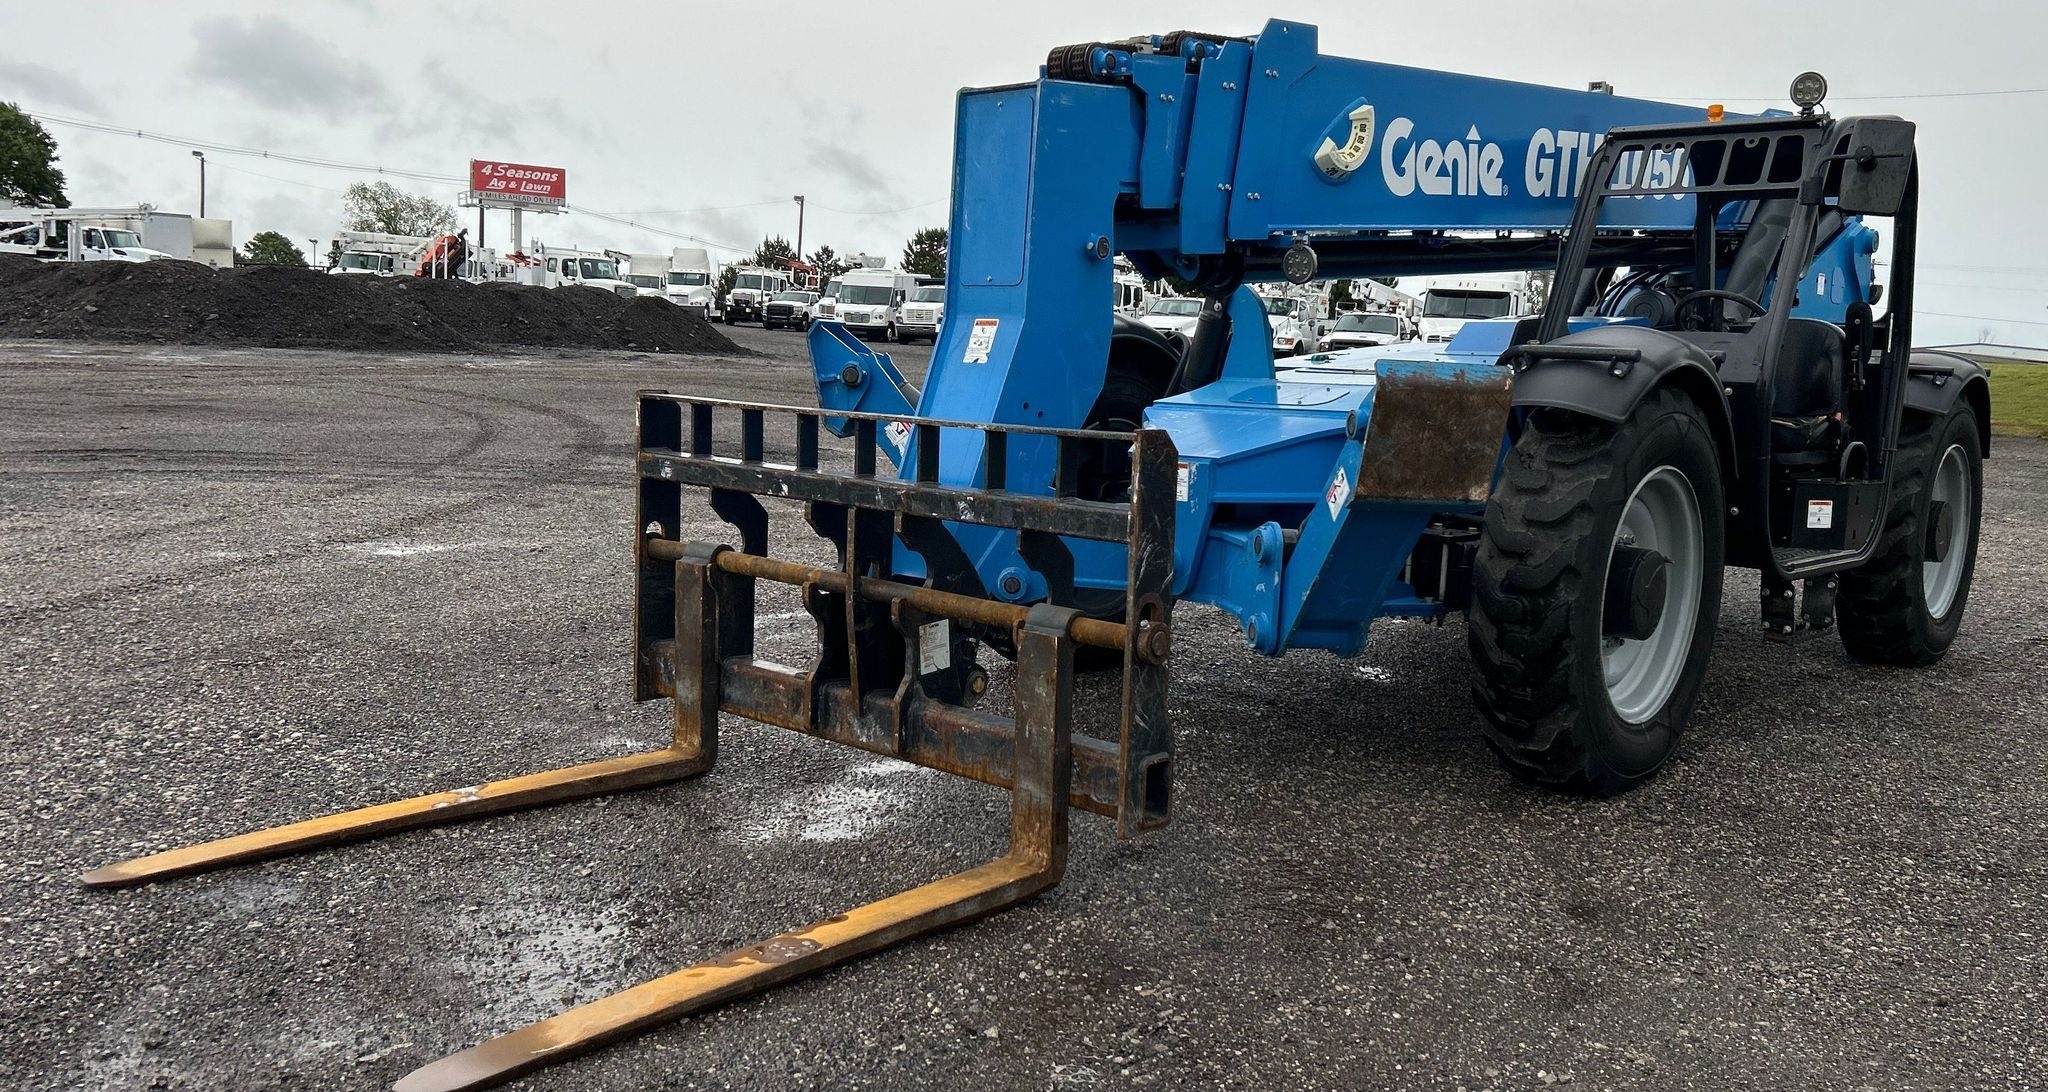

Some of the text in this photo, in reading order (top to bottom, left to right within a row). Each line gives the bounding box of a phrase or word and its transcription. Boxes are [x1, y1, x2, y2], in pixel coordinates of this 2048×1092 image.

[1381, 117, 1504, 196] Genie
[481, 164, 558, 181] 4 Seasons
[488, 178, 507, 189] Ag
[520, 181, 551, 191] Lawn
[485, 192, 507, 200] MILES
[508, 194, 532, 202] AHEAD
[545, 197, 561, 205] LEFT
